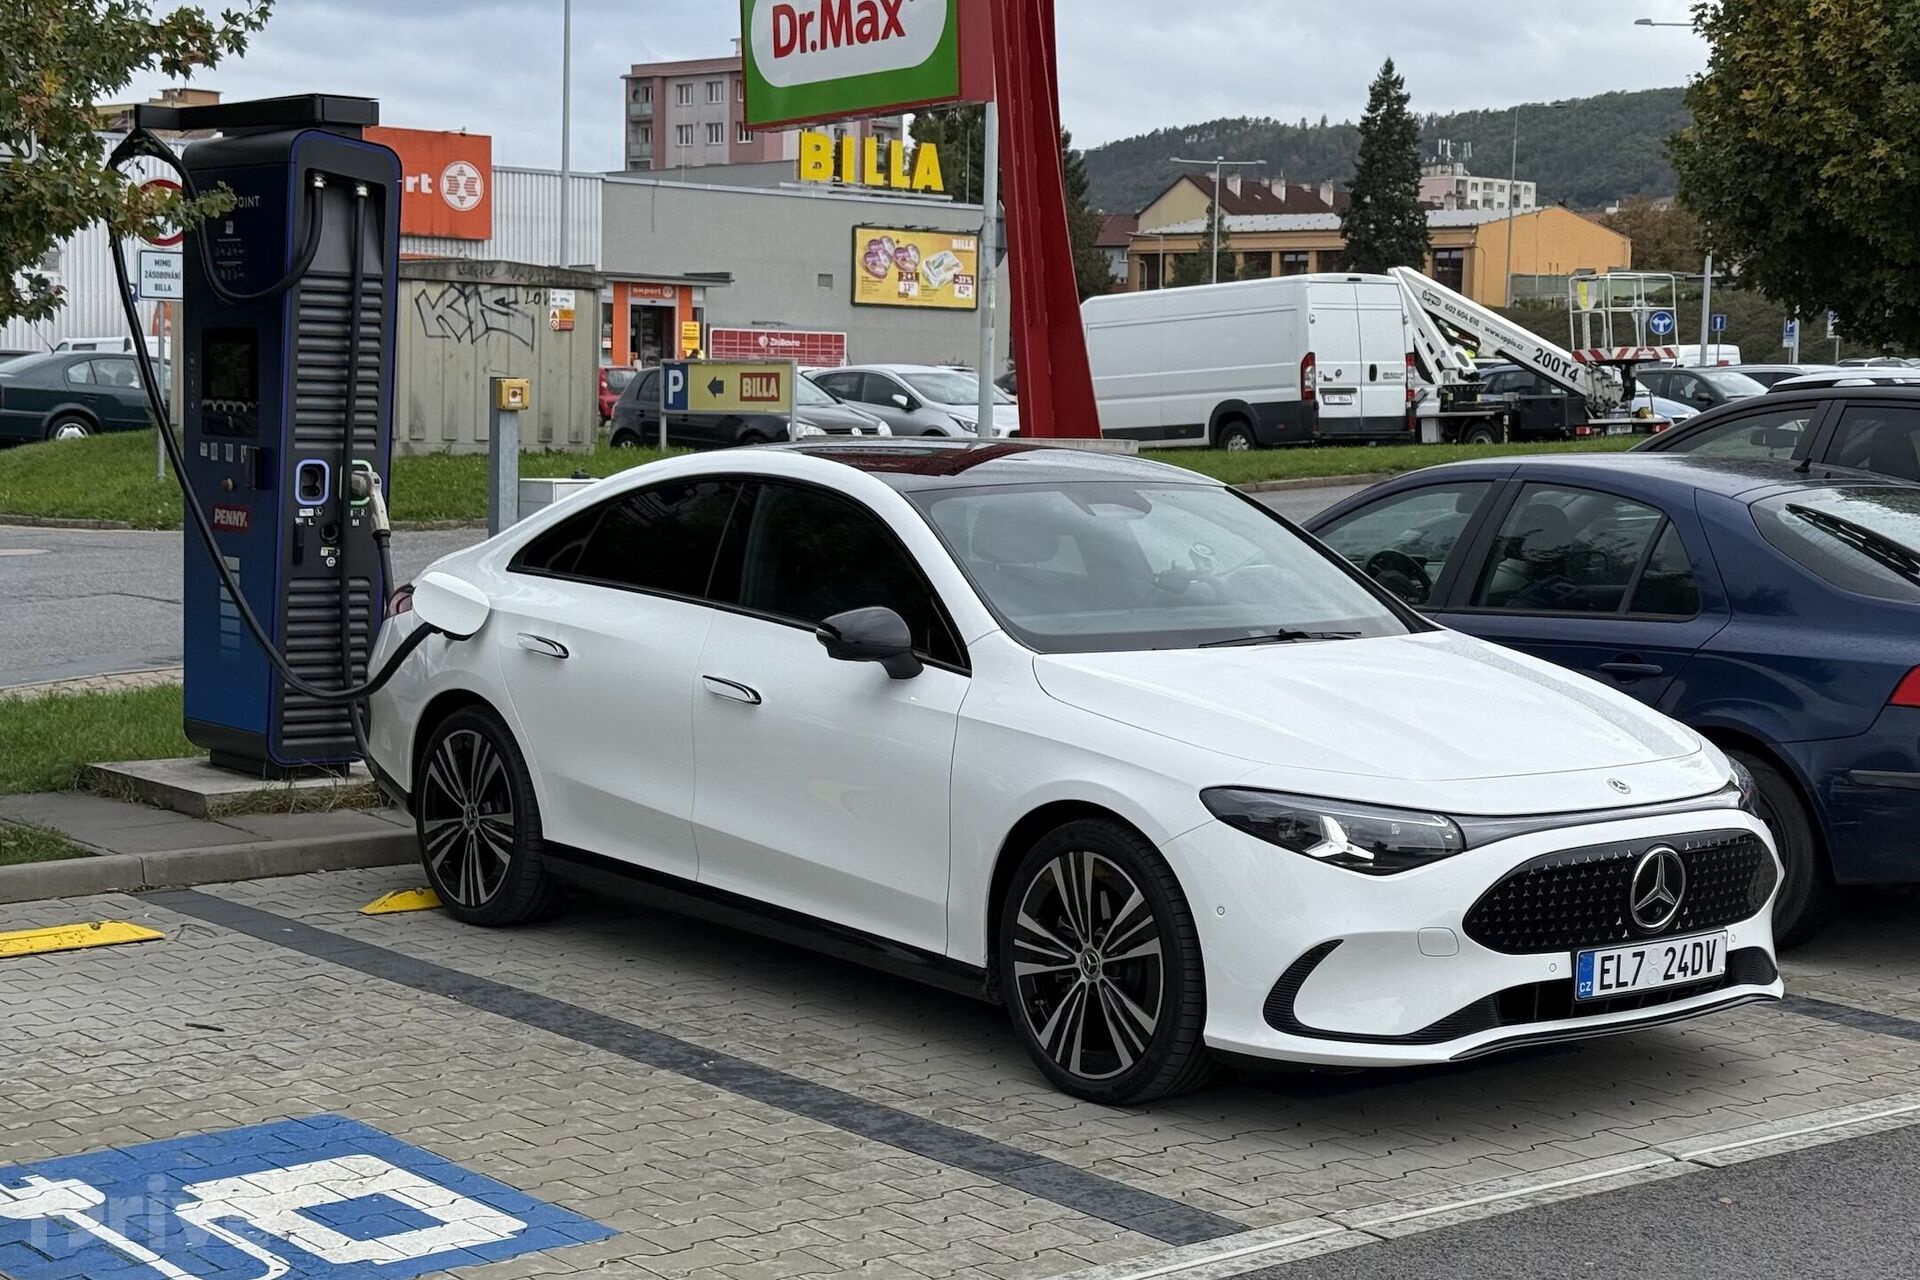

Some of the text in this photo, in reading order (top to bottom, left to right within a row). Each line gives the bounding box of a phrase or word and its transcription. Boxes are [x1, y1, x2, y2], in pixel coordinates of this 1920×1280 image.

[772, 0, 906, 59] Dr.Max
[799, 131, 945, 192] BILLA
[154, 259, 172, 268] MIMO
[154, 282, 172, 292] BILLA
[1533, 347, 1580, 383] 200T4
[668, 369, 778, 405] P BILLA
[352, 519, 360, 527] M
[1599, 938, 1718, 991] EL7 24DV
[1579, 981, 1592, 993] CZ
